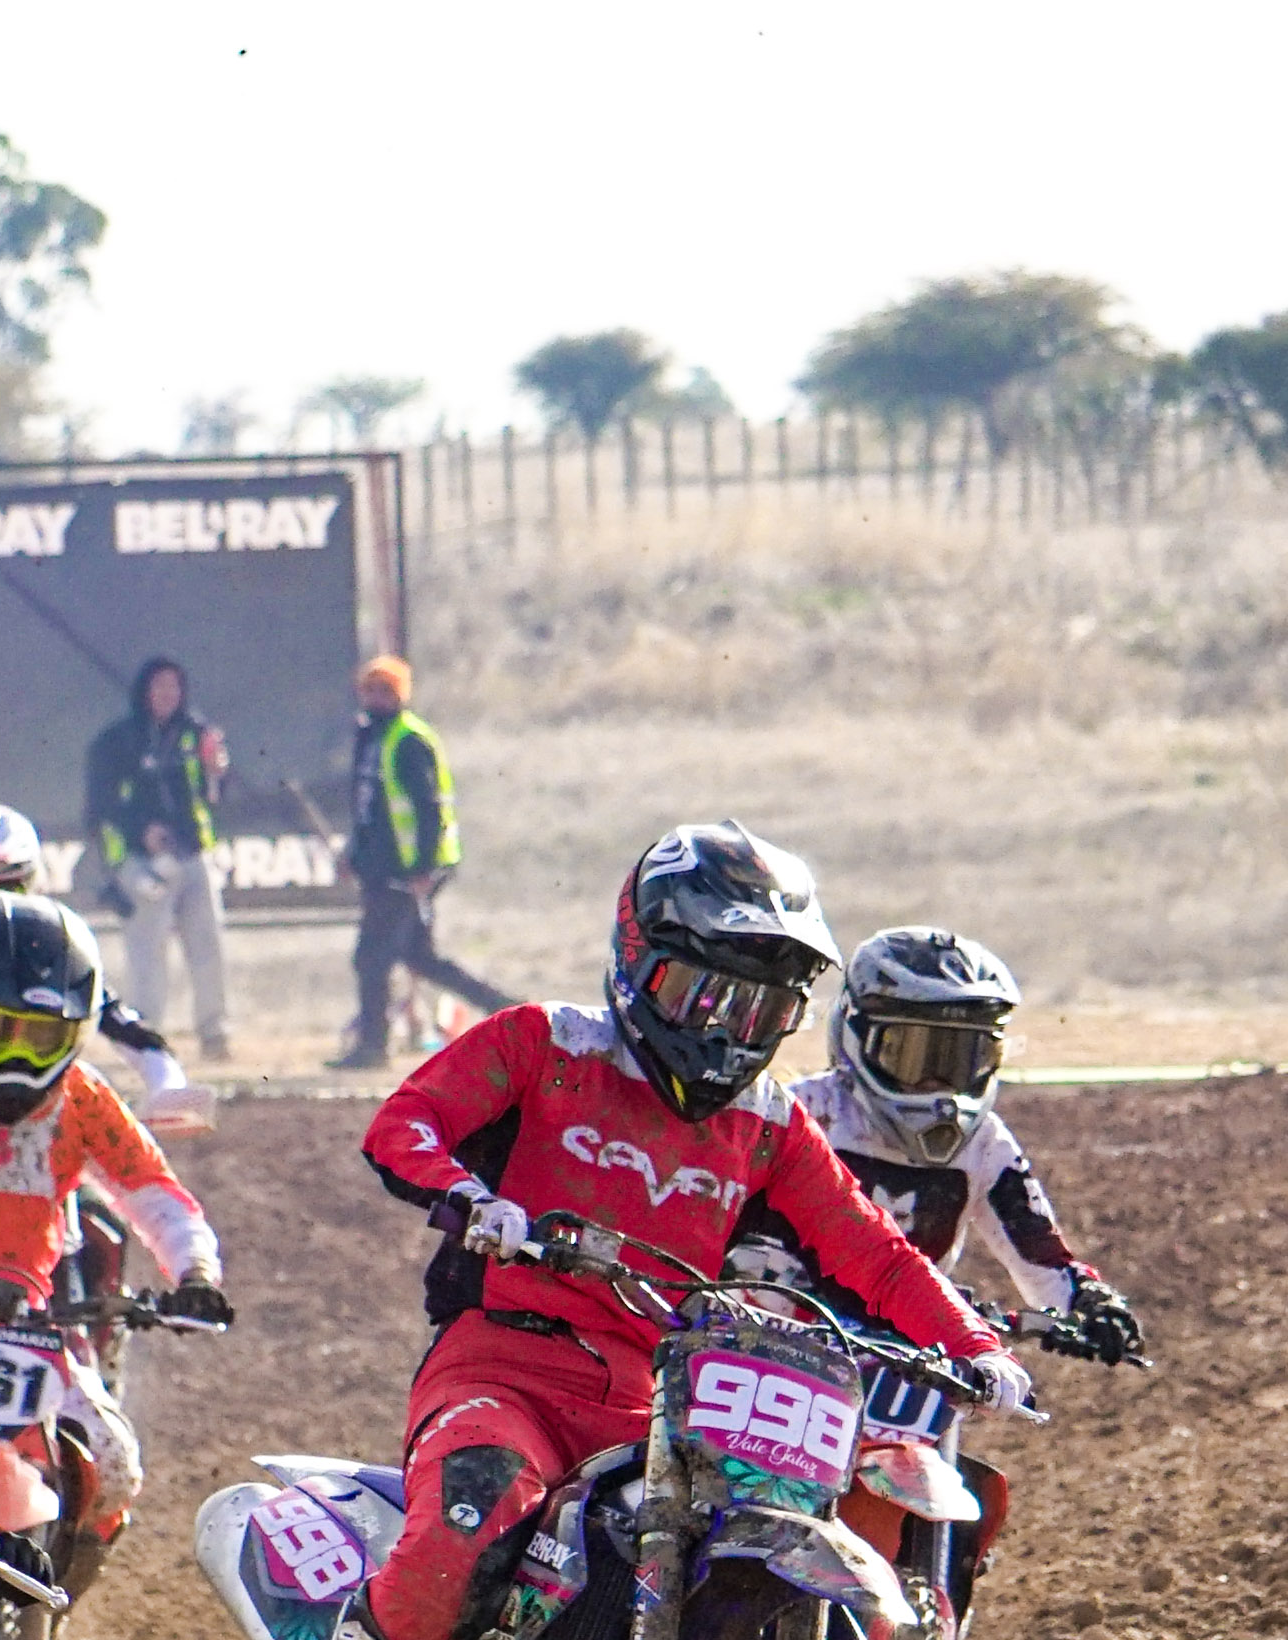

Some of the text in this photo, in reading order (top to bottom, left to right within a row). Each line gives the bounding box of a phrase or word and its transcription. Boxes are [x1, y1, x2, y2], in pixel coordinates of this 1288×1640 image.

[687, 1362, 858, 1471] 998
[726, 1431, 819, 1480] Vale Galaz
[251, 1499, 364, 1601] 998
